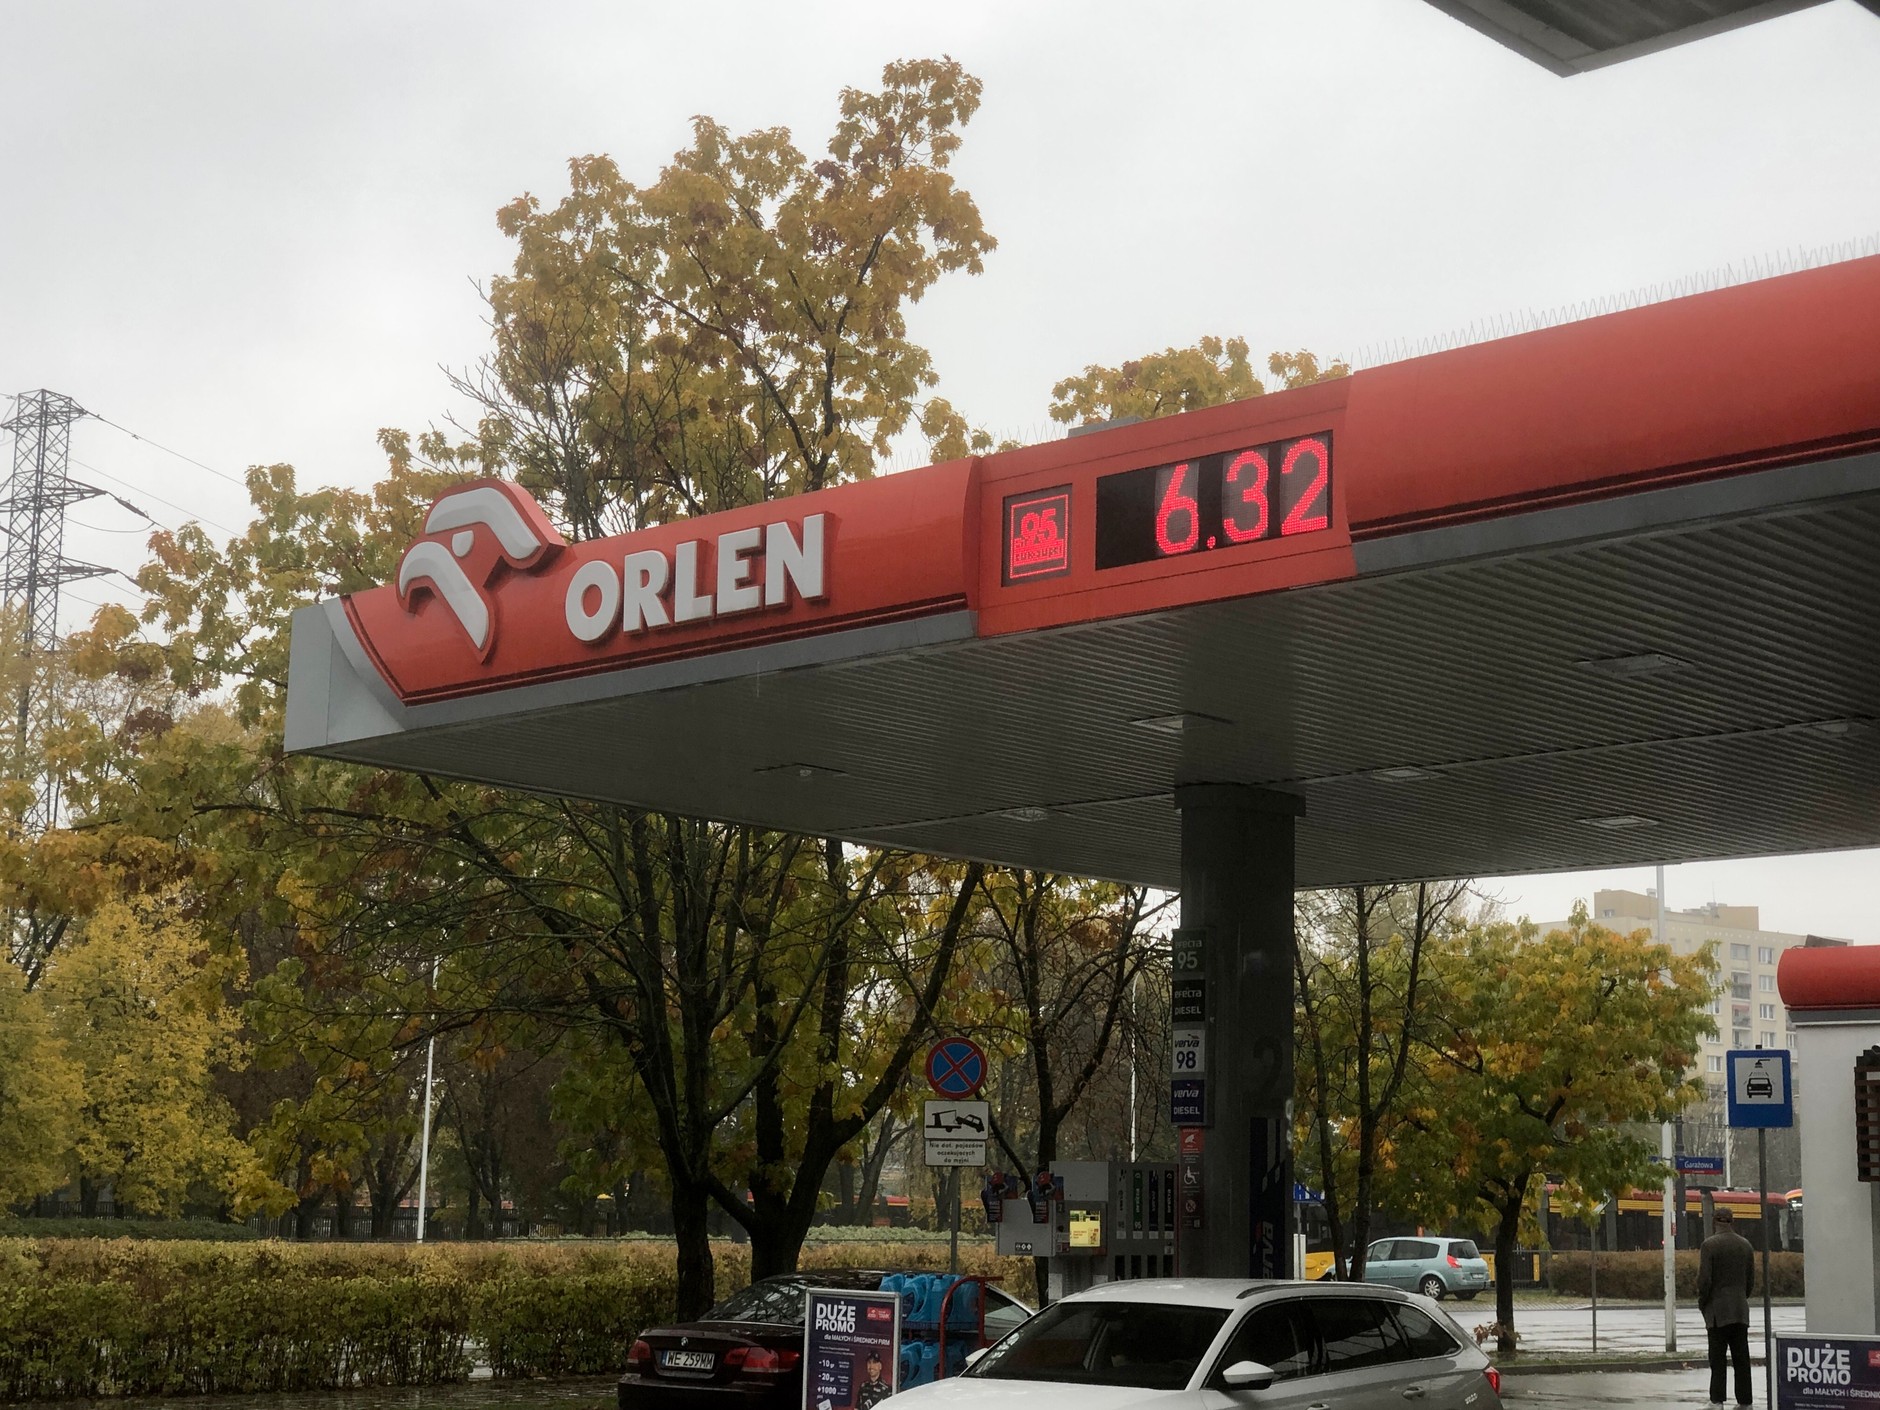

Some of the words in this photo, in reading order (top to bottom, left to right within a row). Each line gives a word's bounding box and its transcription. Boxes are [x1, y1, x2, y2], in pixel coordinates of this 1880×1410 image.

[1155, 437, 1329, 556] 6.32
[1020, 507, 1057, 543] 95
[565, 513, 825, 642] ORLEN
[1177, 951, 1198, 969] 95
[1174, 988, 1202, 999] efecta
[1174, 1005, 1202, 1015] DIESEL
[1174, 1037, 1200, 1048] verva
[1176, 1051, 1196, 1069] 98
[1173, 1088, 1199, 1098] verva
[1173, 1106, 1200, 1115] DIESEL
[1684, 1160, 1714, 1169] Garażowa
[1262, 1220, 1274, 1279] erva
[816, 1300, 857, 1322] DUŻE
[815, 1318, 856, 1333] PROMO
[878, 1338, 891, 1346] FIRM
[667, 1351, 682, 1366] WE
[1787, 1343, 1851, 1370] DUŻE
[1786, 1367, 1851, 1385] PROMO
[1802, 1387, 1814, 1395] dla
[1814, 1388, 1845, 1396] MAŁYCH
